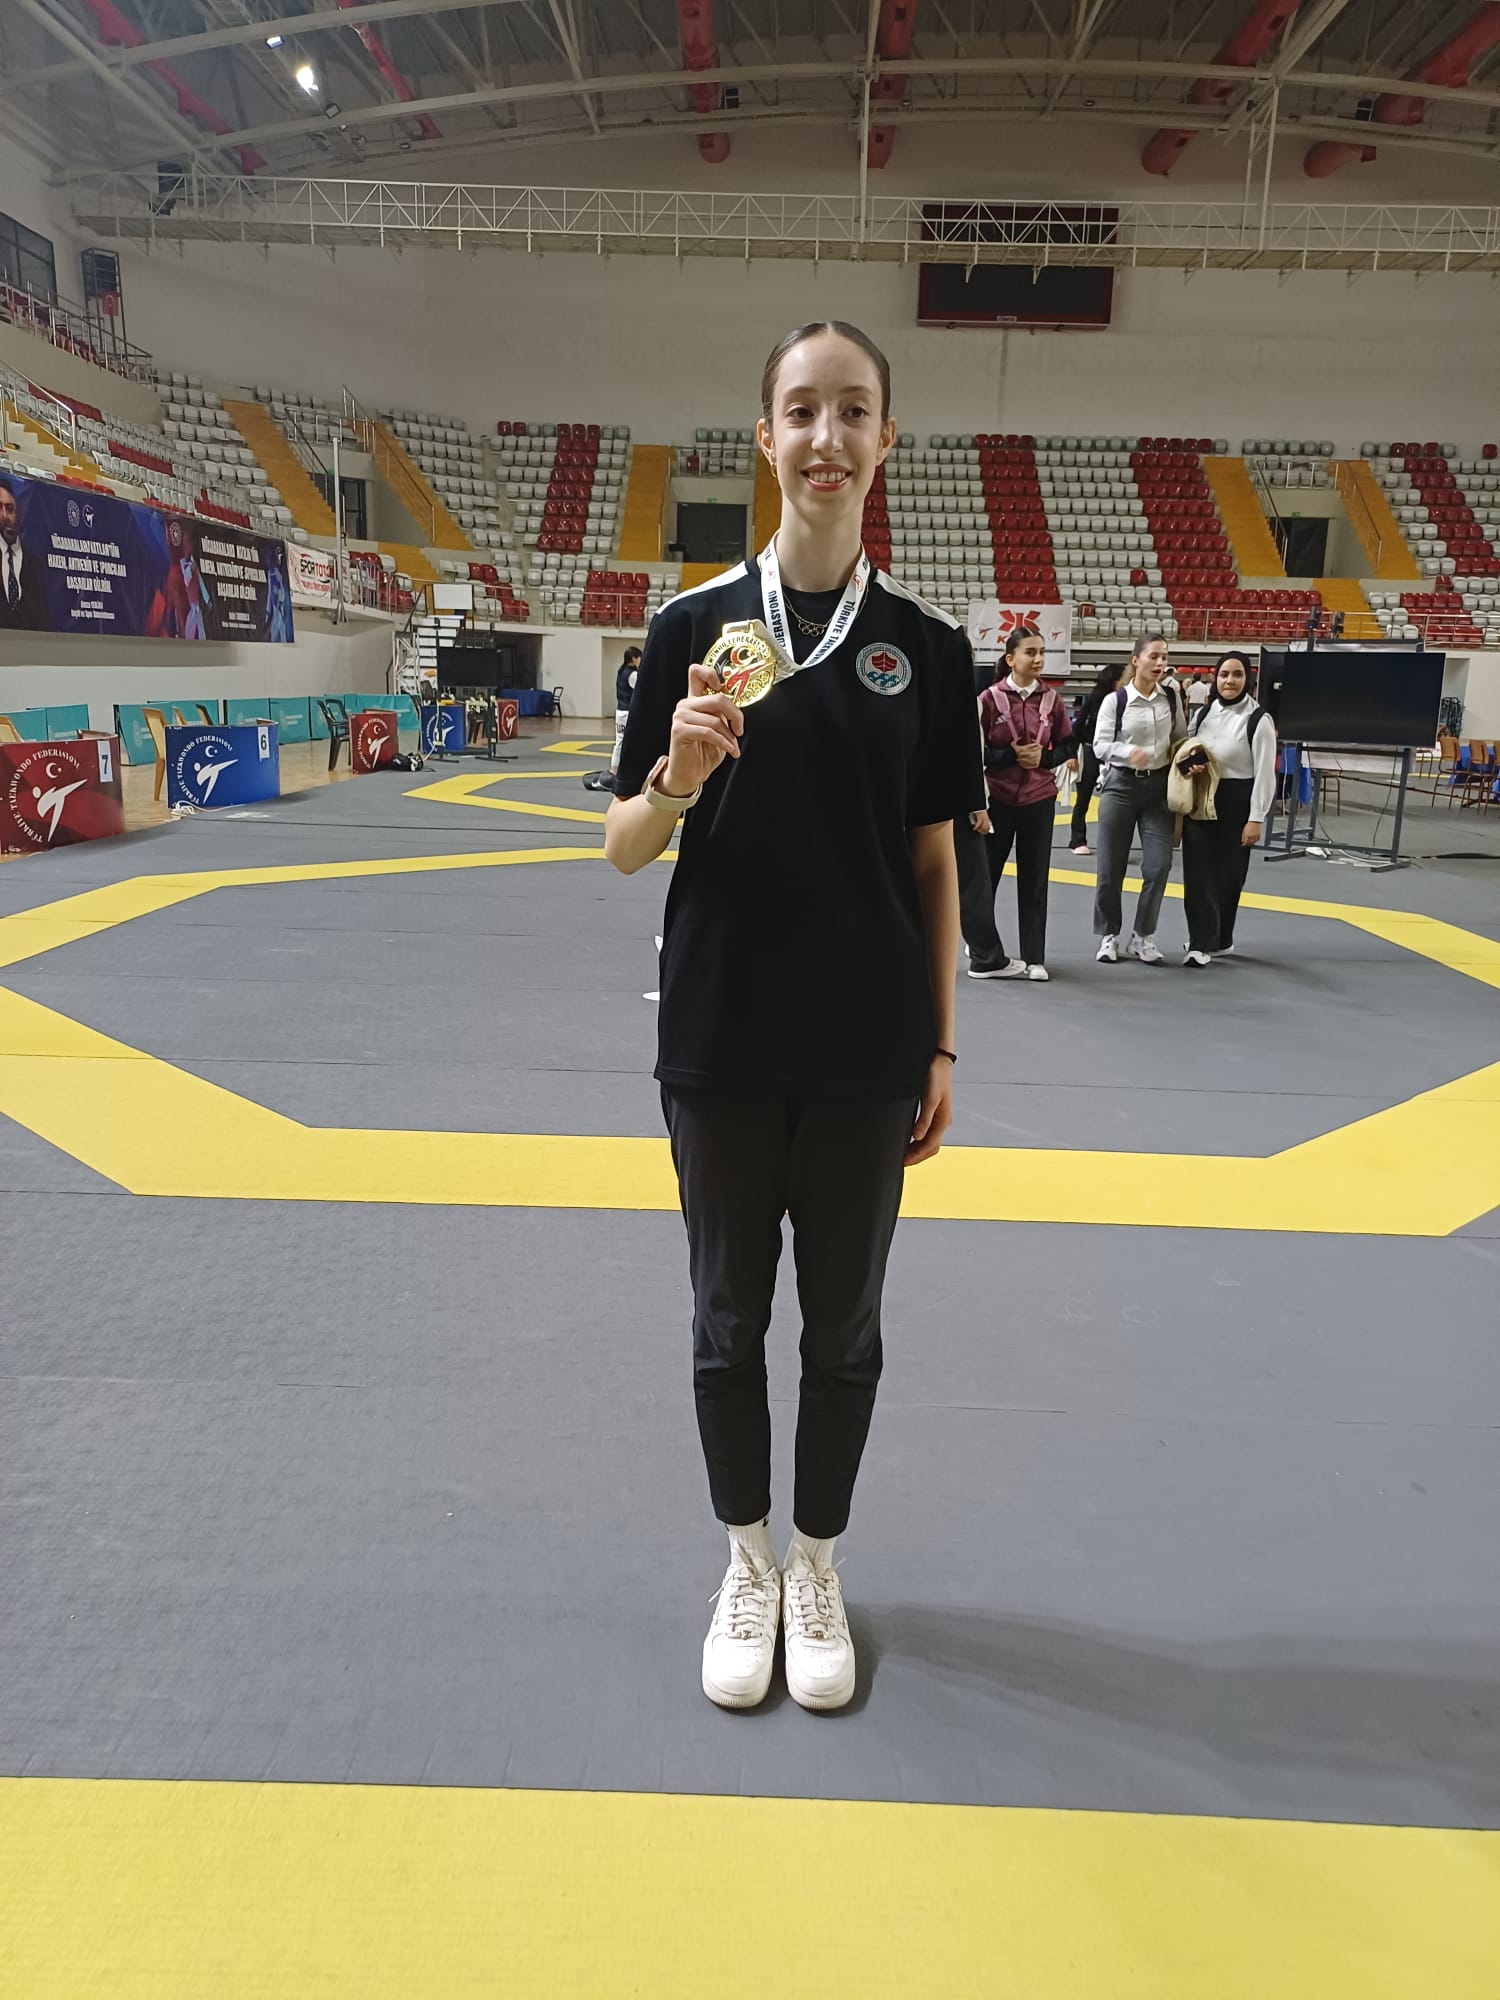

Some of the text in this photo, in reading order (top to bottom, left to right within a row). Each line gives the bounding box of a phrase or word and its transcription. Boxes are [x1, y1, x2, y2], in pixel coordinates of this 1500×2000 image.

[836, 600, 856, 635] TÜRKİYE
[260, 734, 267, 751] 6
[101, 754, 109, 775] 7
